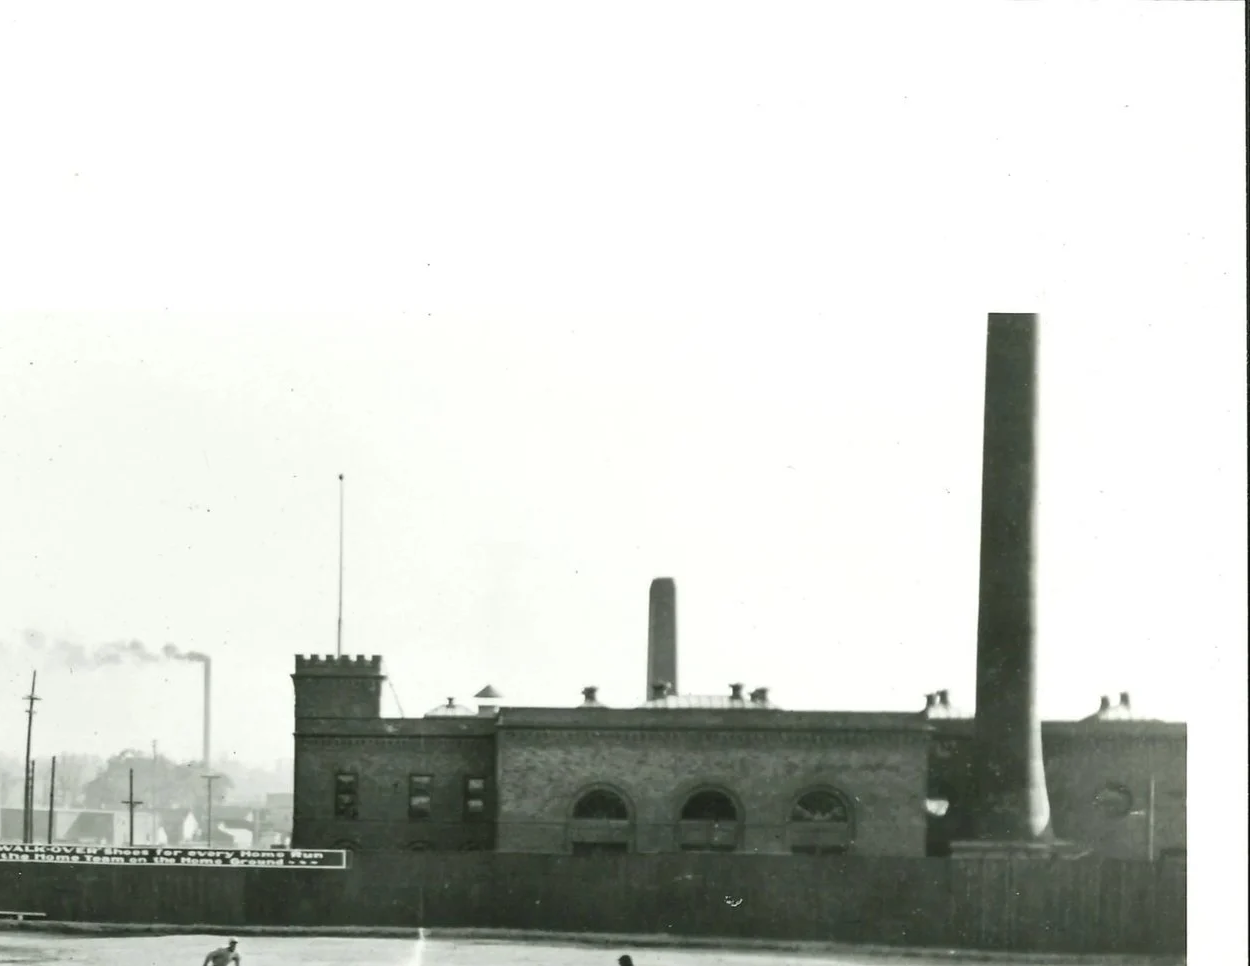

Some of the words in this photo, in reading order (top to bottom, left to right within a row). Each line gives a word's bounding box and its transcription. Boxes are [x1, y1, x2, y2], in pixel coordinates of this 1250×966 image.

[104, 847, 149, 856] Shoes
[155, 847, 183, 857] for
[188, 849, 234, 859] every
[240, 850, 285, 858] Home
[290, 849, 324, 859] Run
[1, 853, 30, 861] the
[34, 853, 80, 862] Home
[84, 855, 125, 864] Team
[153, 856, 176, 864] the
[180, 857, 223, 865] Home
[230, 857, 284, 866] Ground
